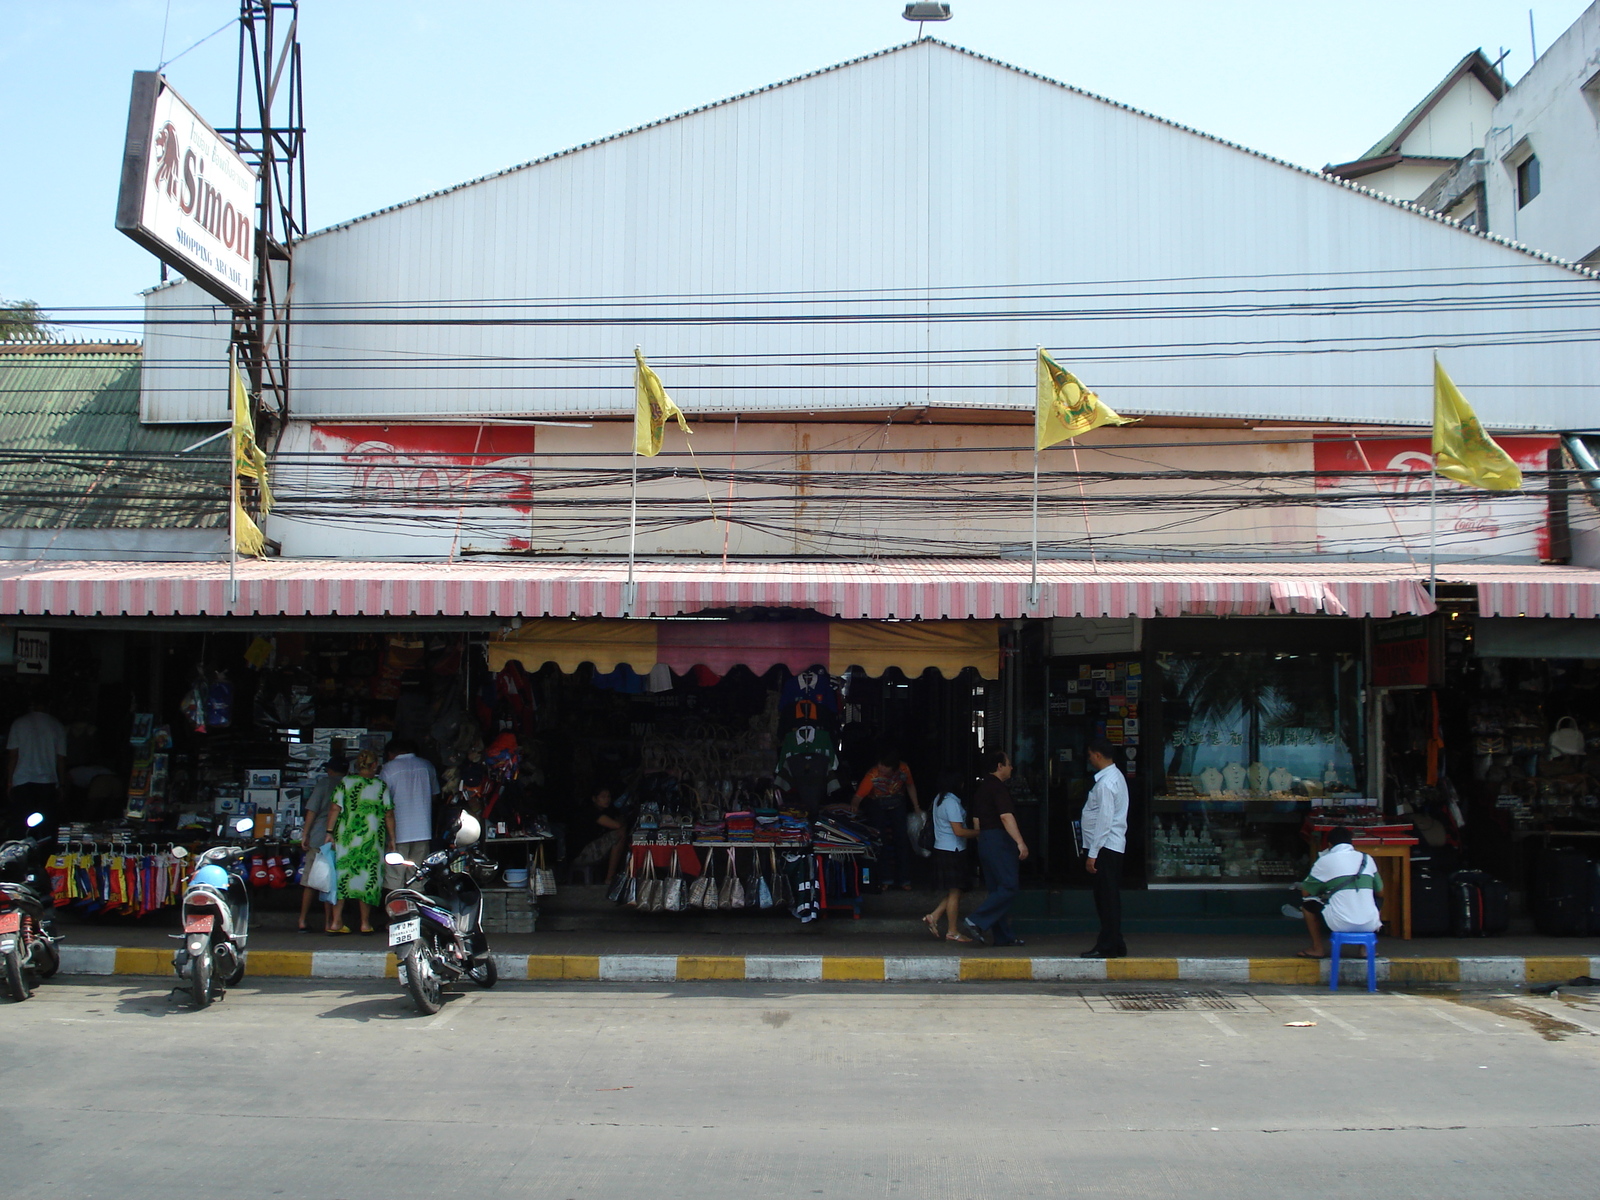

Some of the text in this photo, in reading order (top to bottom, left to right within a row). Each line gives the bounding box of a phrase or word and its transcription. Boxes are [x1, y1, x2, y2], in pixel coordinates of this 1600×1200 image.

[179, 148, 250, 262] Simon
[176, 227, 213, 266] SHOPPING
[215, 257, 242, 287] ARCADE
[19, 638, 47, 659] TATTOO
[396, 933, 412, 944] 325
